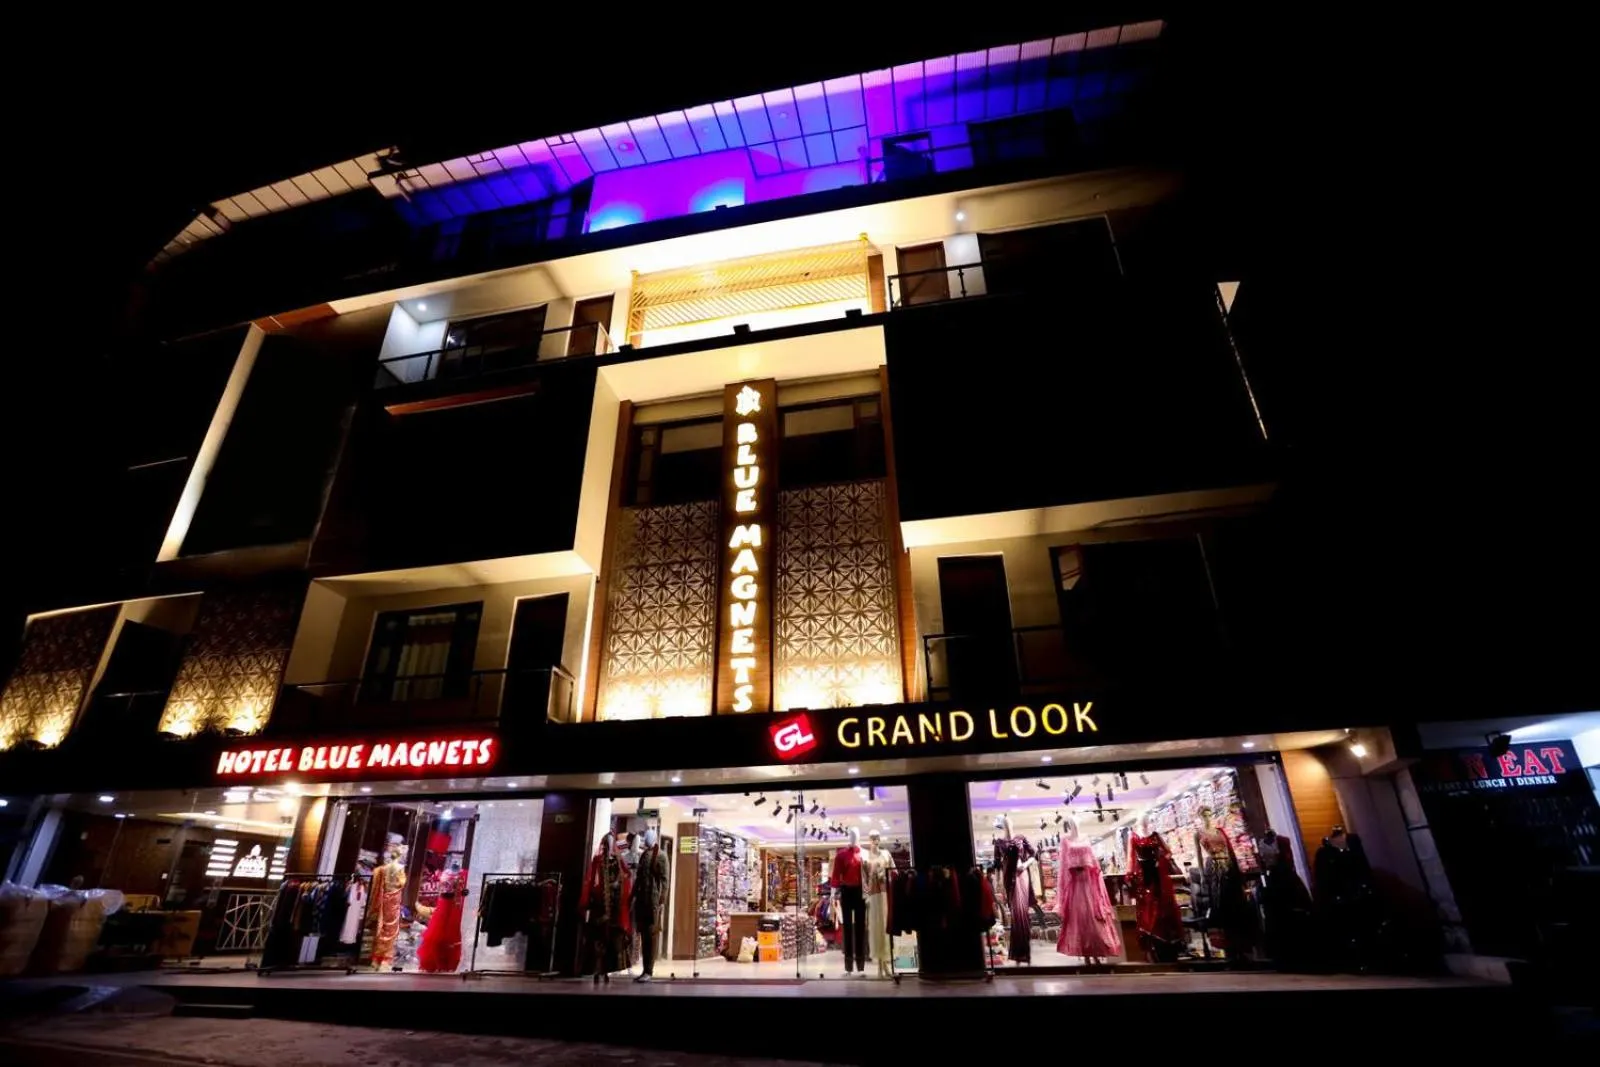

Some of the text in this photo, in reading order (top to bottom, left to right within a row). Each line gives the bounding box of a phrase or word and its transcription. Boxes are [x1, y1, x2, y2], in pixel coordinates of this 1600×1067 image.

[729, 422, 761, 713] BLUE MAGNETS
[773, 723, 814, 752] GL
[837, 702, 1098, 748] GRAND LOOK
[216, 738, 493, 774] HOTEL BLUE MAGNETS
[1498, 747, 1566, 777] EAT
[1472, 777, 1507, 788] LUNCH
[1518, 775, 1557, 786] DINNER
